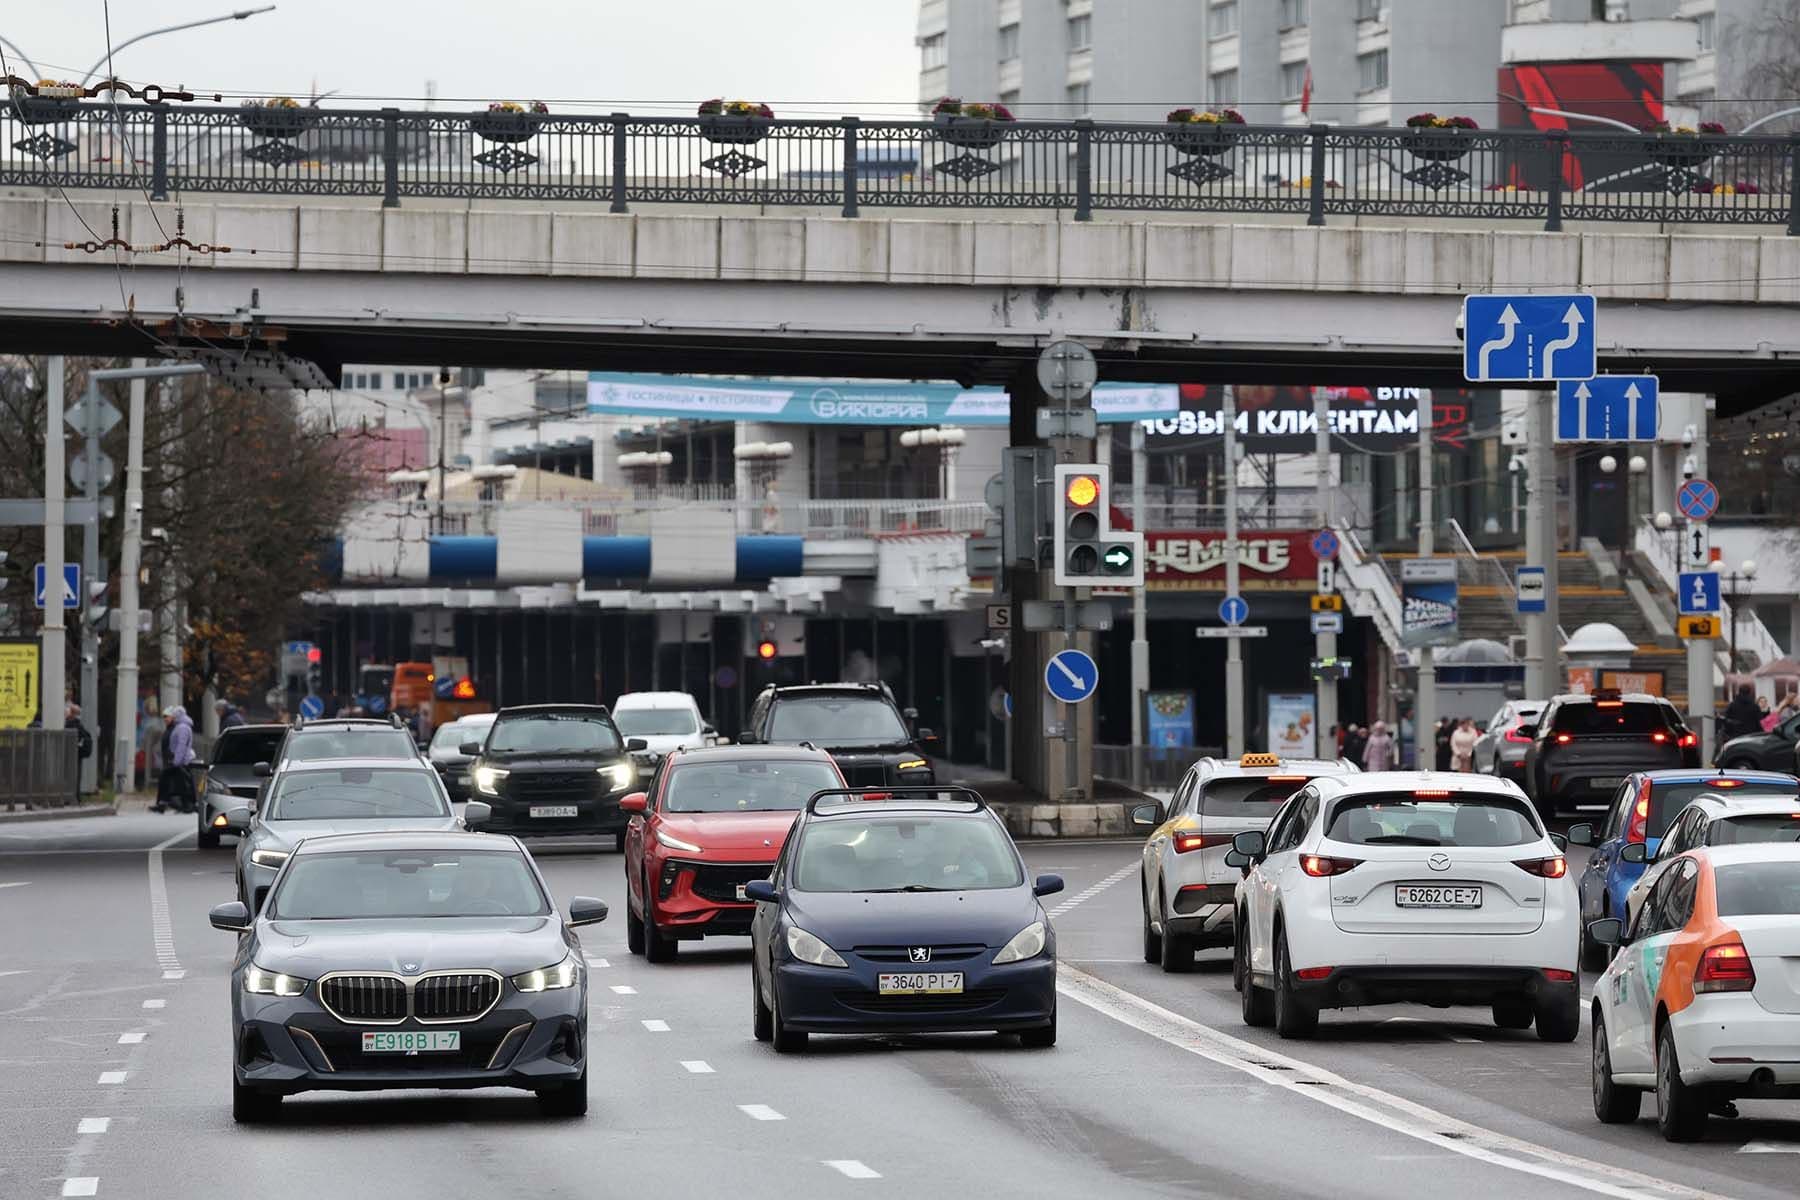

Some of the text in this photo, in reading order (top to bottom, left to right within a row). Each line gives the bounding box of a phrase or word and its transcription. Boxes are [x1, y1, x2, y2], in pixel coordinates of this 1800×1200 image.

[996, 608, 1009, 625] S
[1409, 889, 1479, 903] 6262 CE-7
[892, 974, 961, 989] 3640 PI-7
